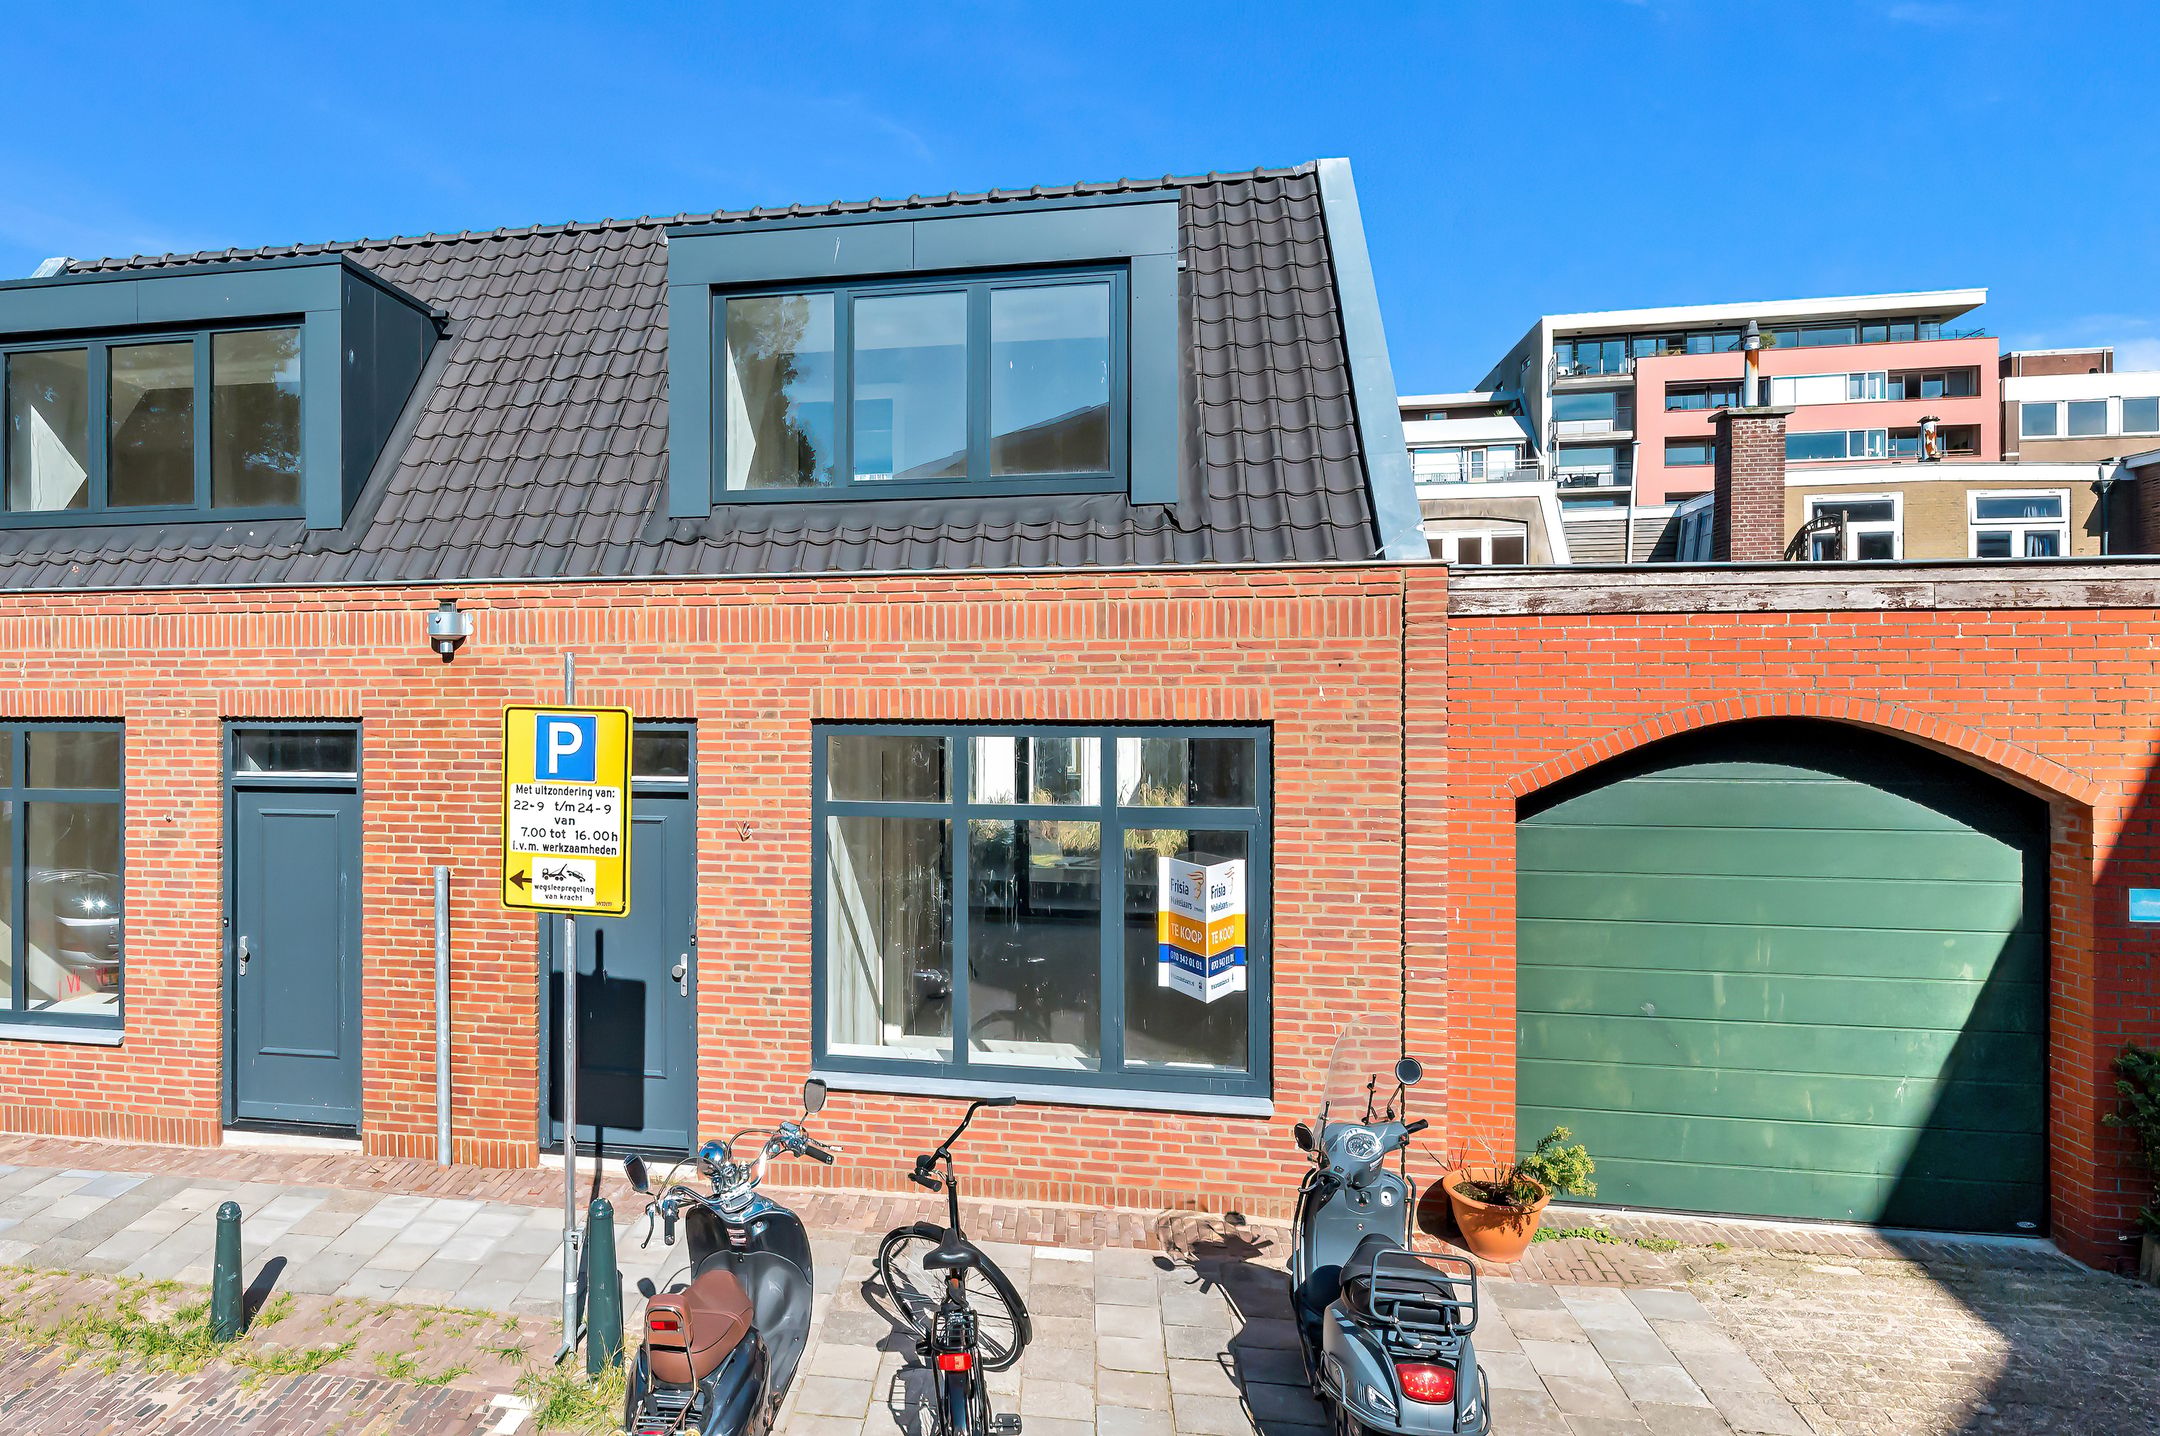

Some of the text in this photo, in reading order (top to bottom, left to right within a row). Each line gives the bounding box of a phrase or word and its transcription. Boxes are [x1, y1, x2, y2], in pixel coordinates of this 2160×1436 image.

[548, 722, 582, 773] P
[515, 784, 615, 800] Met uitzondering van:
[554, 801, 575, 812] t/m
[554, 817, 576, 826] van
[521, 826, 546, 838] 7.00
[550, 829, 566, 839] tot
[512, 840, 617, 856] i.v.m. werkzaamheden
[534, 884, 595, 895] wegsleepregeling
[1170, 877, 1190, 896] Frisia
[1211, 883, 1226, 900] Frisia
[560, 893, 583, 902] kracht
[1170, 922, 1203, 944] TE KOOP
[1211, 925, 1235, 945] TE KOOP
